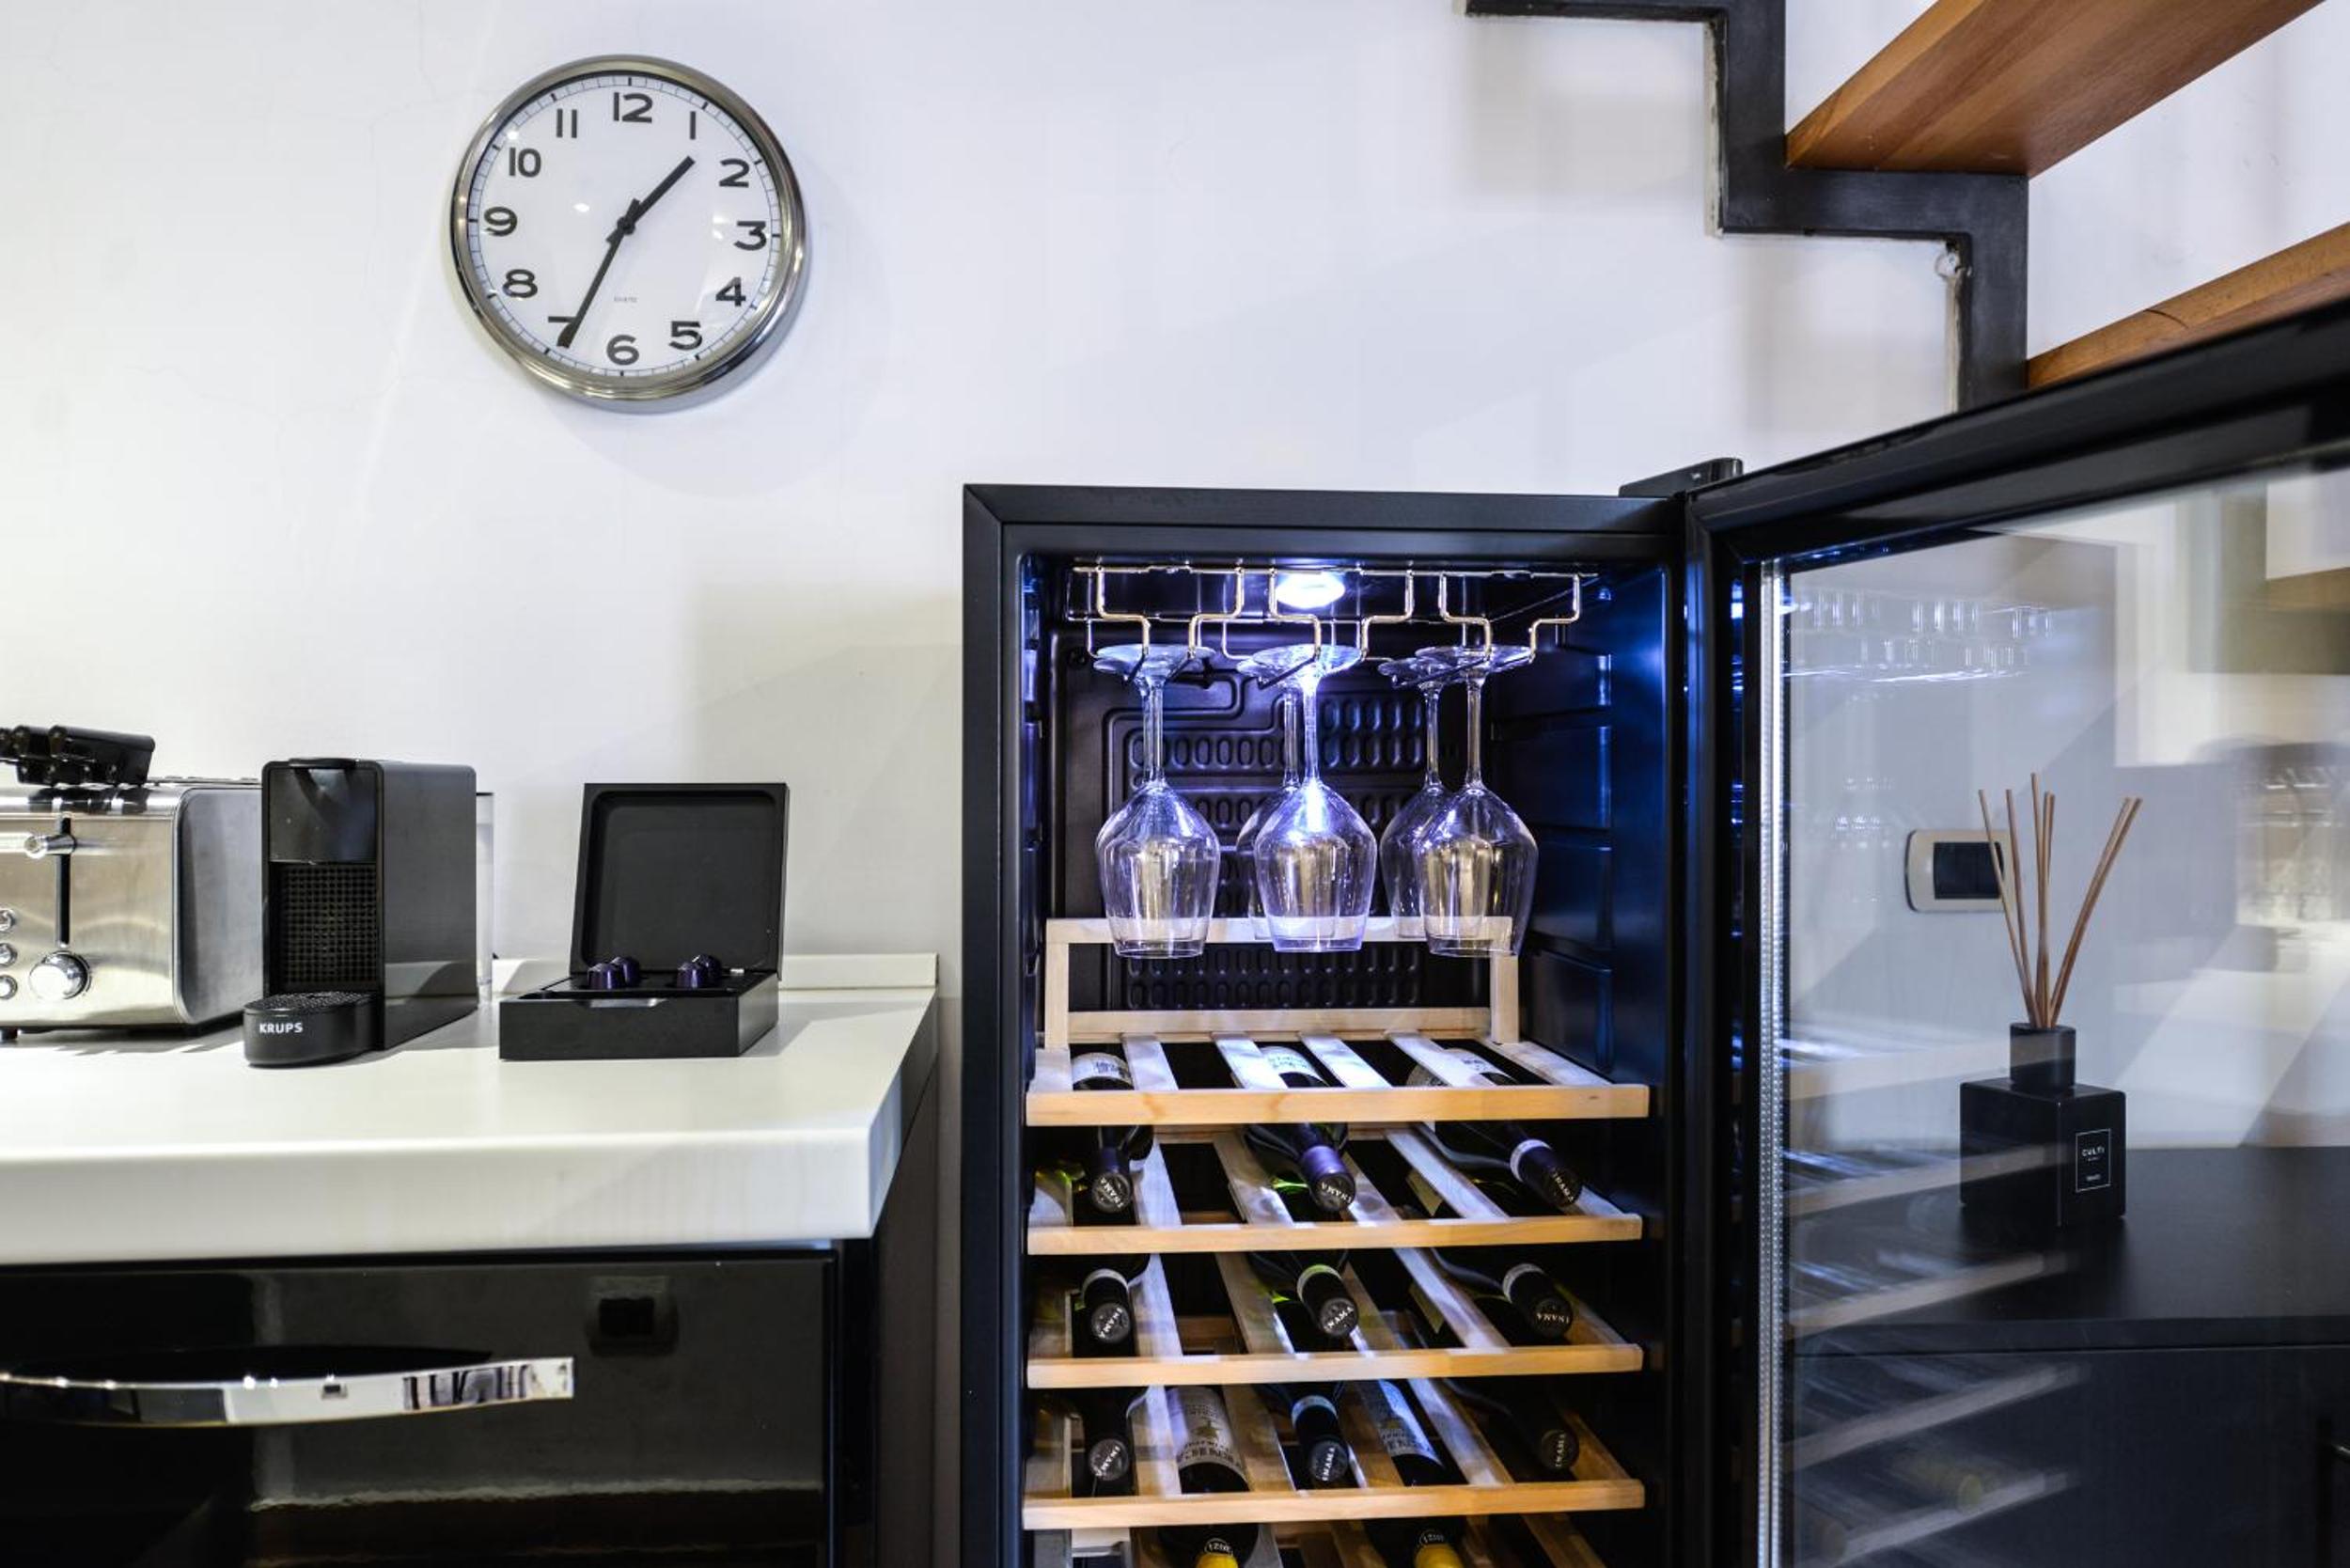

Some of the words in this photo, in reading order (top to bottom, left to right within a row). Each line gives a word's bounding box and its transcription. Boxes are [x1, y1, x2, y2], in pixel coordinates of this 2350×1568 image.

[613, 91, 653, 123] 12
[556, 108, 578, 138] 11
[689, 111, 697, 140] 1
[509, 147, 542, 178] 10
[718, 158, 750, 188] 2
[483, 206, 518, 237] 9
[733, 220, 768, 251] 3
[502, 268, 539, 299] 8
[715, 276, 747, 307] 4
[606, 334, 640, 366] 6
[668, 321, 703, 352] 5
[258, 1022, 304, 1034] KRUPS
